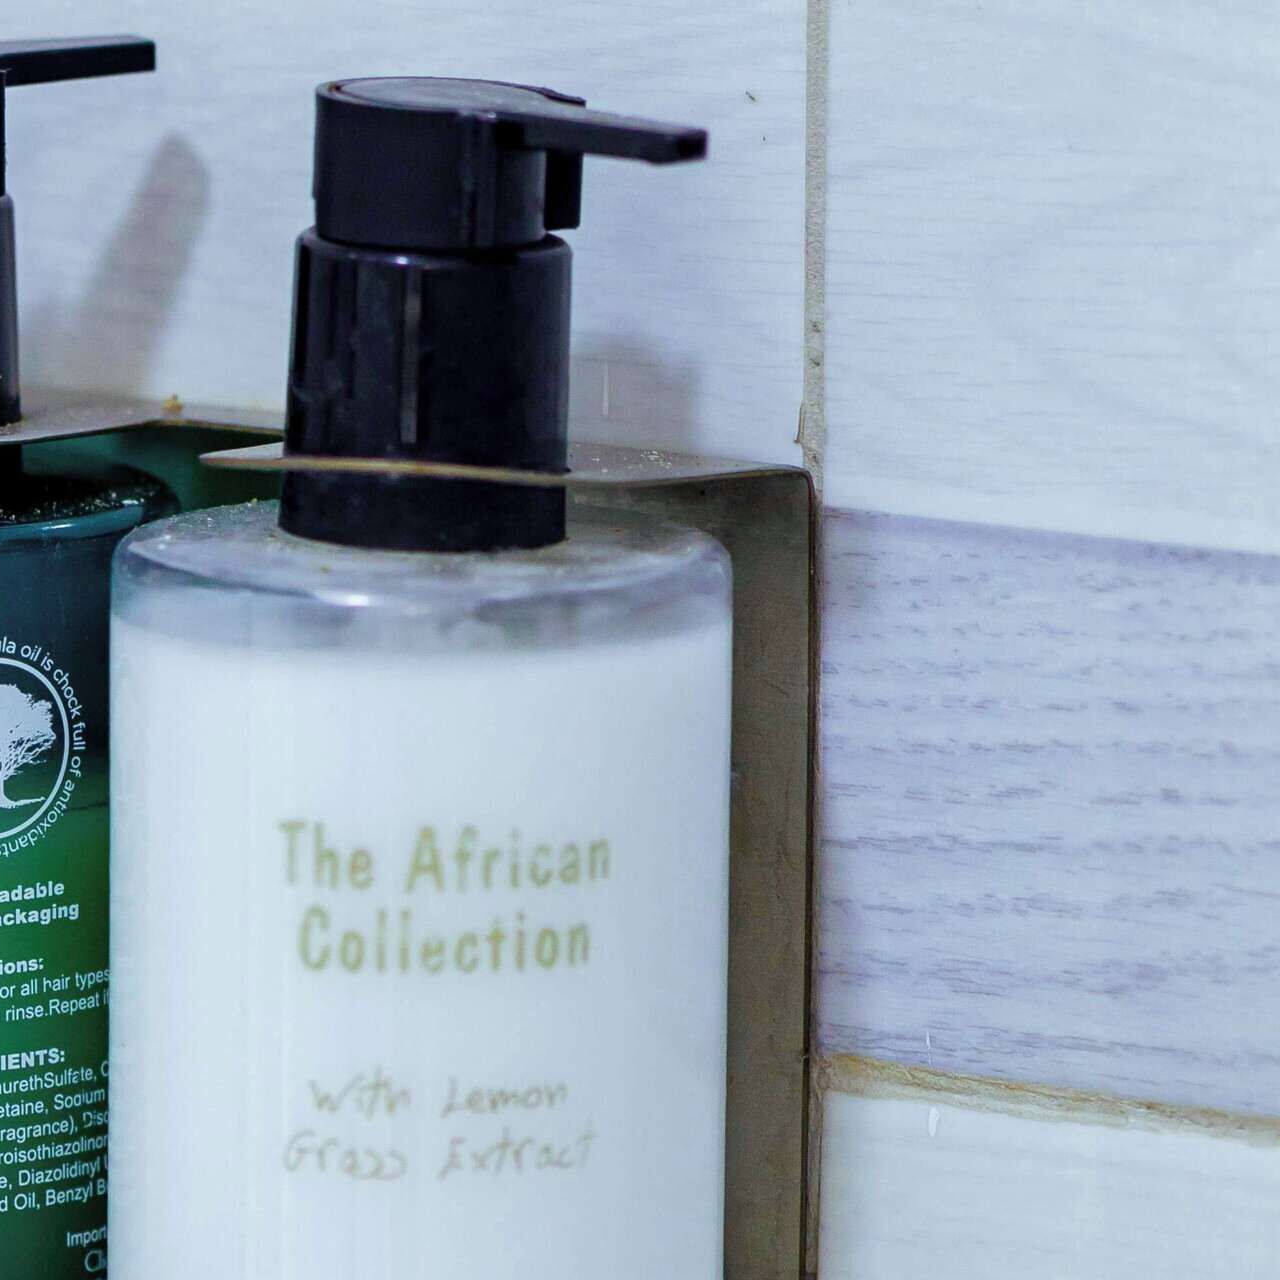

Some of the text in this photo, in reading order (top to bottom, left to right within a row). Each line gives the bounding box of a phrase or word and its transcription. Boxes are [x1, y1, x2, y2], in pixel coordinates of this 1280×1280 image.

[20, 644, 42, 661] oil
[40, 652, 54, 671] is
[53, 668, 84, 718] chock
[72, 721, 87, 751] full
[71, 756, 82, 778] of
[278, 819, 611, 894] The African
[298, 904, 592, 974] Collection
[20, 978, 38, 996] all
[43, 974, 71, 993] hair
[53, 1088, 106, 1111] Sodium
[440, 1075, 569, 1120] Lemon
[283, 1114, 597, 1182] Grass Extract
[18, 1156, 101, 1187] Diazolidinyl
[13, 1191, 40, 1210] Oil,
[45, 1181, 93, 1207] Benzyl
